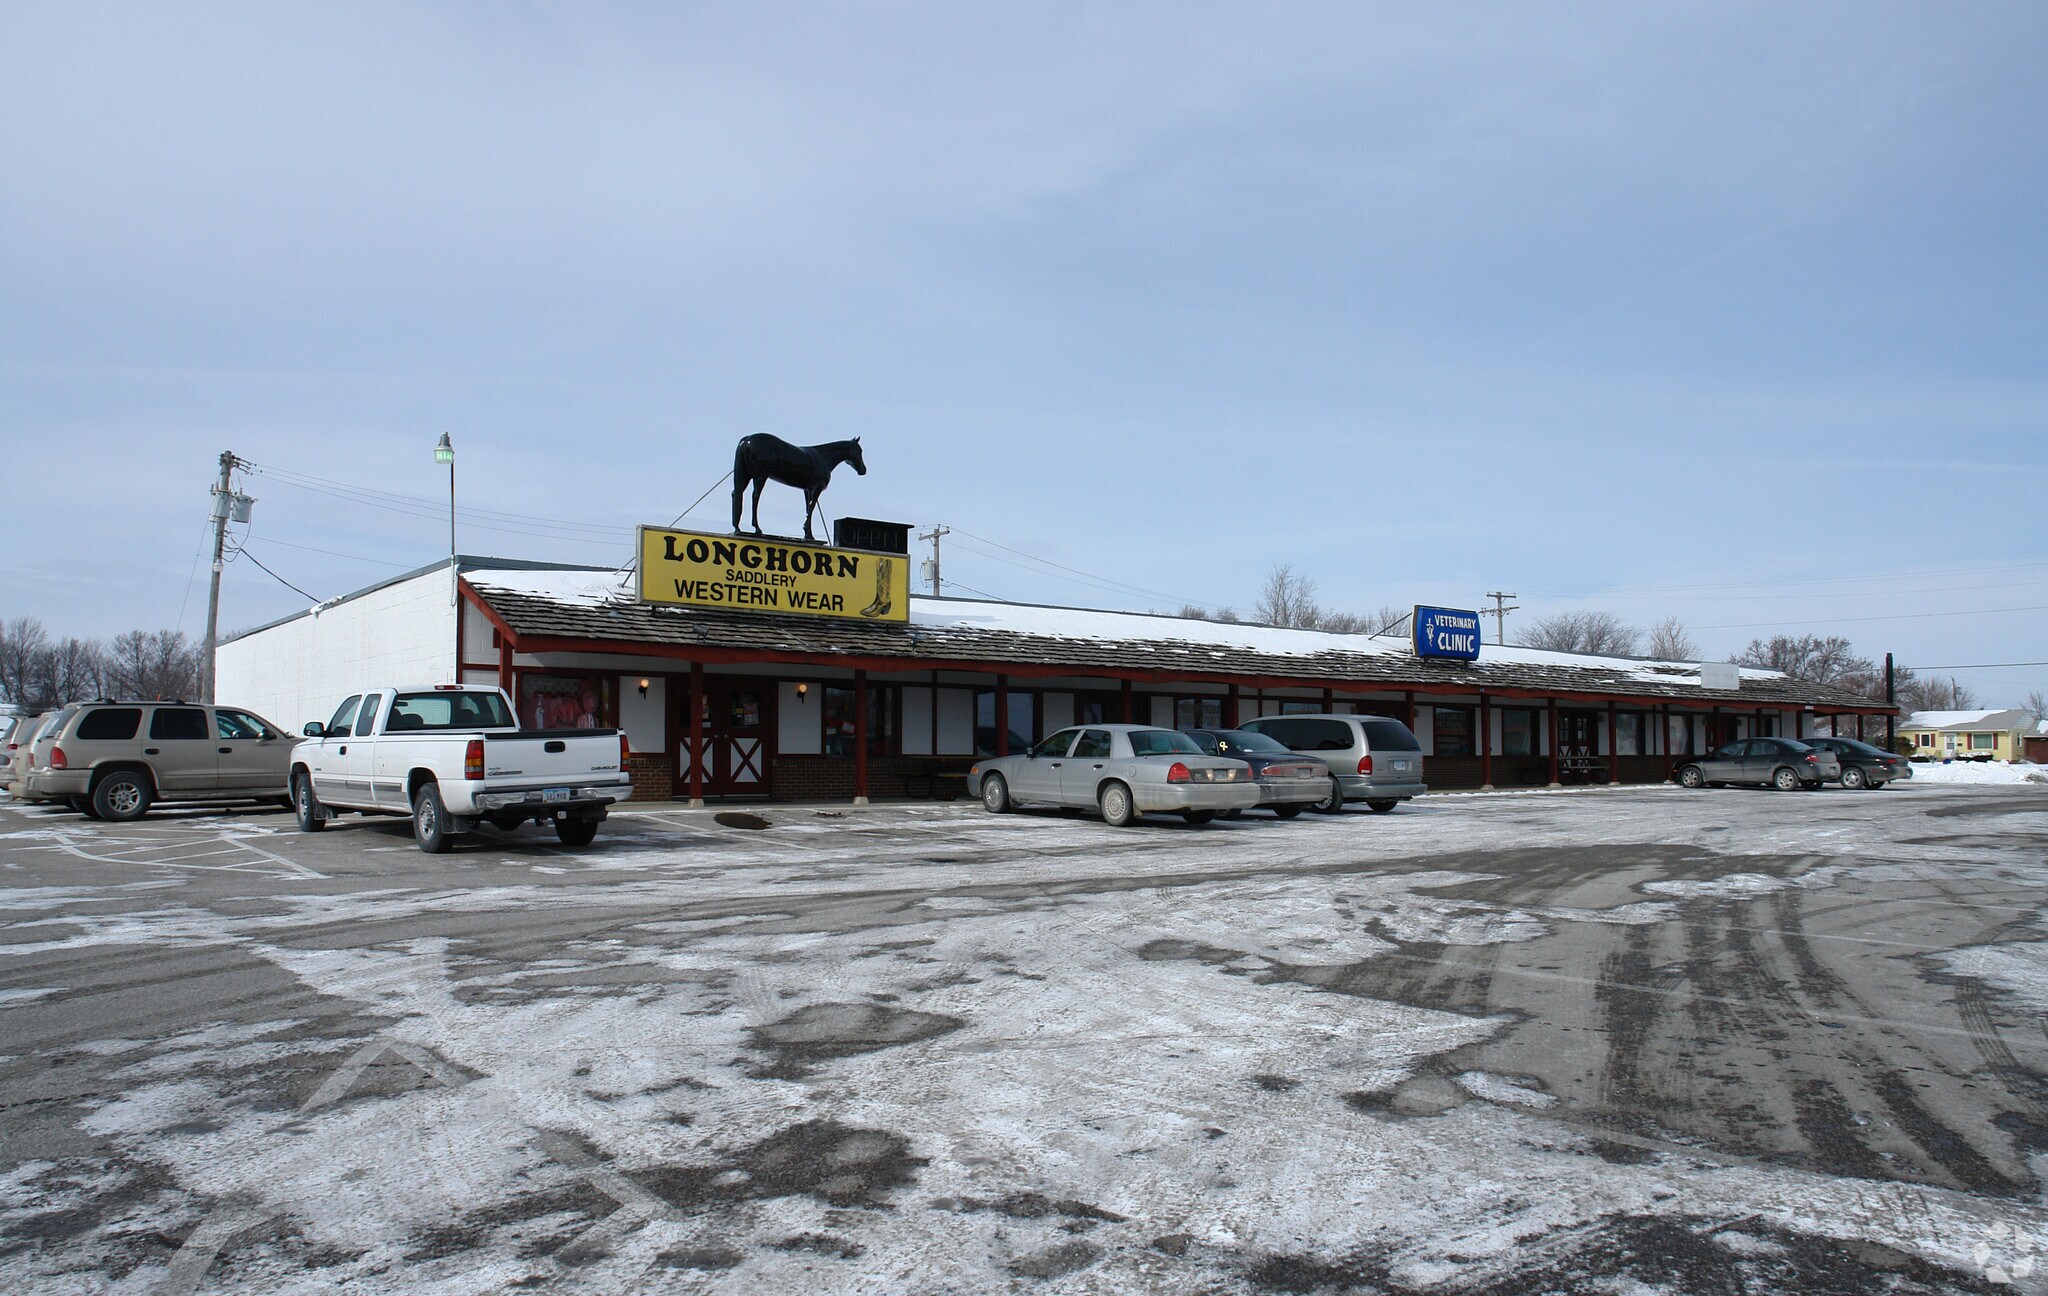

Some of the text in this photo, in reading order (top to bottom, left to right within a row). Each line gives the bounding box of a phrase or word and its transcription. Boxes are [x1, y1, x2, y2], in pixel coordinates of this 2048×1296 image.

[841, 524, 898, 549] OPEN
[663, 535, 860, 579] LONGHORN
[725, 568, 797, 588] SADDLERY
[674, 578, 844, 612] WESTERN WEAR
[1434, 614, 1477, 630] VETERINARY
[1437, 632, 1475, 653] CLINIC
